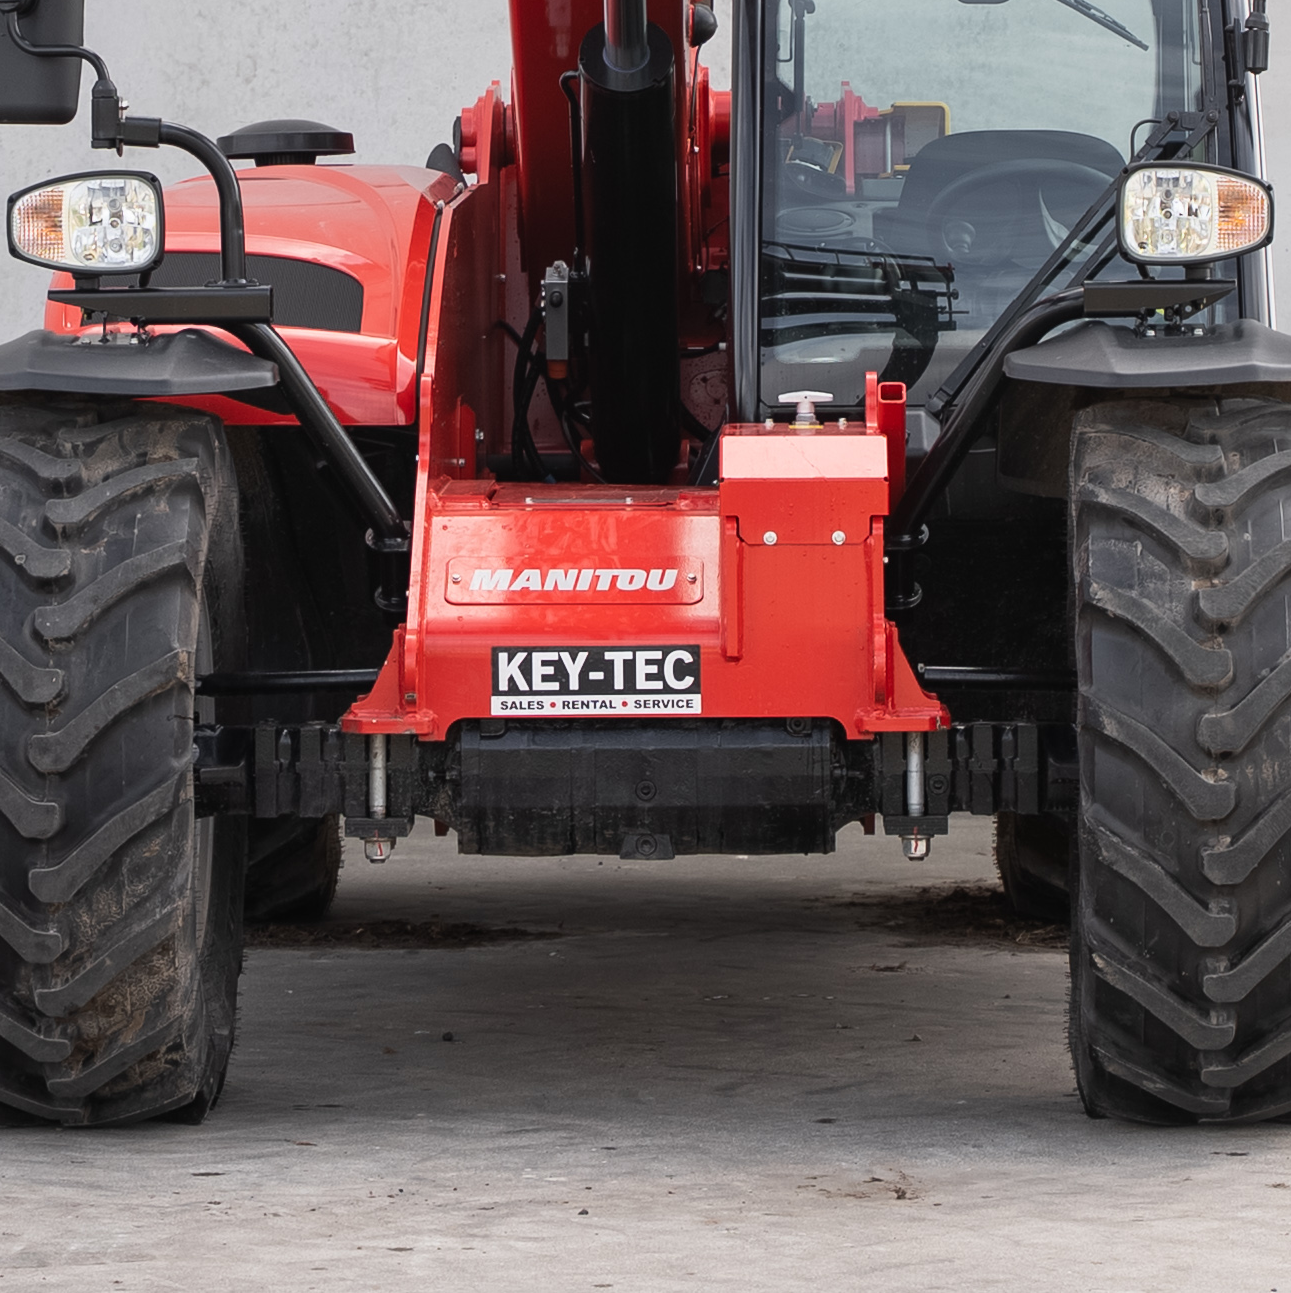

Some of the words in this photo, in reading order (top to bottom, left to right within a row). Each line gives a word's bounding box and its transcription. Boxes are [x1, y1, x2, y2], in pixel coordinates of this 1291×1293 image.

[469, 568, 679, 591] MANITOU
[497, 649, 695, 692] KEY-TEC
[500, 700, 545, 710] SALES
[561, 699, 617, 710] RENTAL
[633, 698, 694, 709] SERVICE
